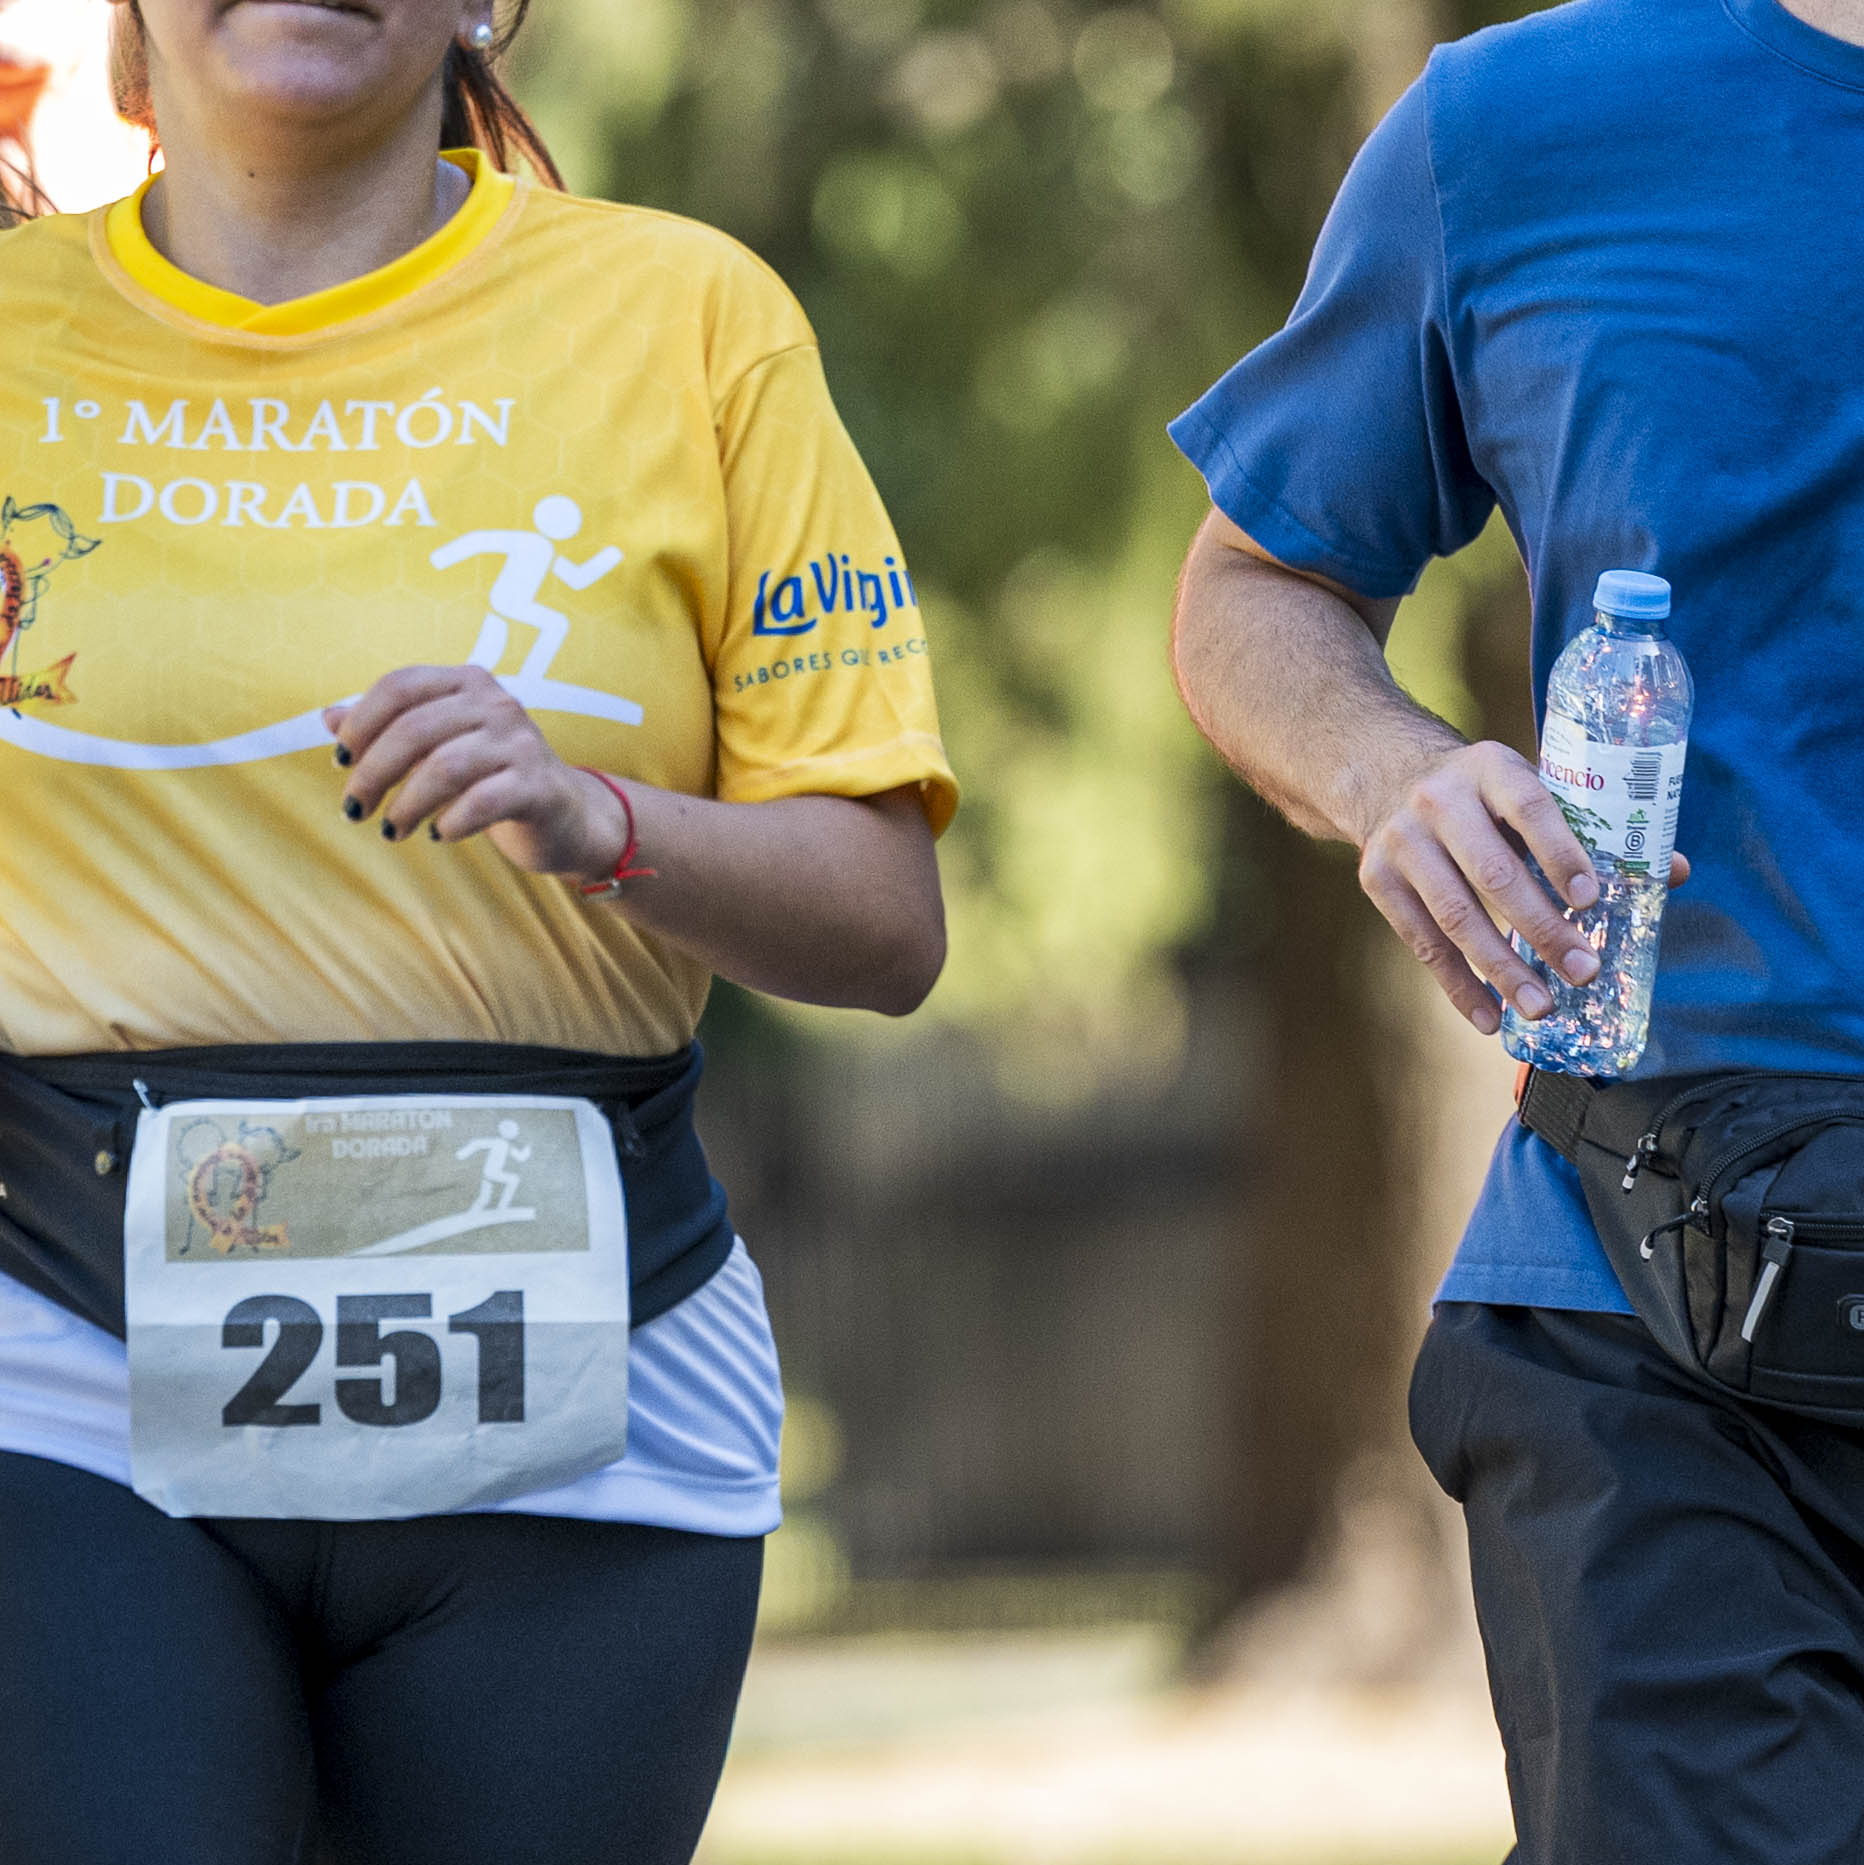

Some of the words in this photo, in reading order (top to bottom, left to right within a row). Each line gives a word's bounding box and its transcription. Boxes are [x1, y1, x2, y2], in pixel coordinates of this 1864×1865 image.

[118, 387, 516, 451] MARATÓN
[98, 472, 439, 528] DORADA
[734, 651, 832, 693] SABORES
[221, 1290, 525, 1428] 251
